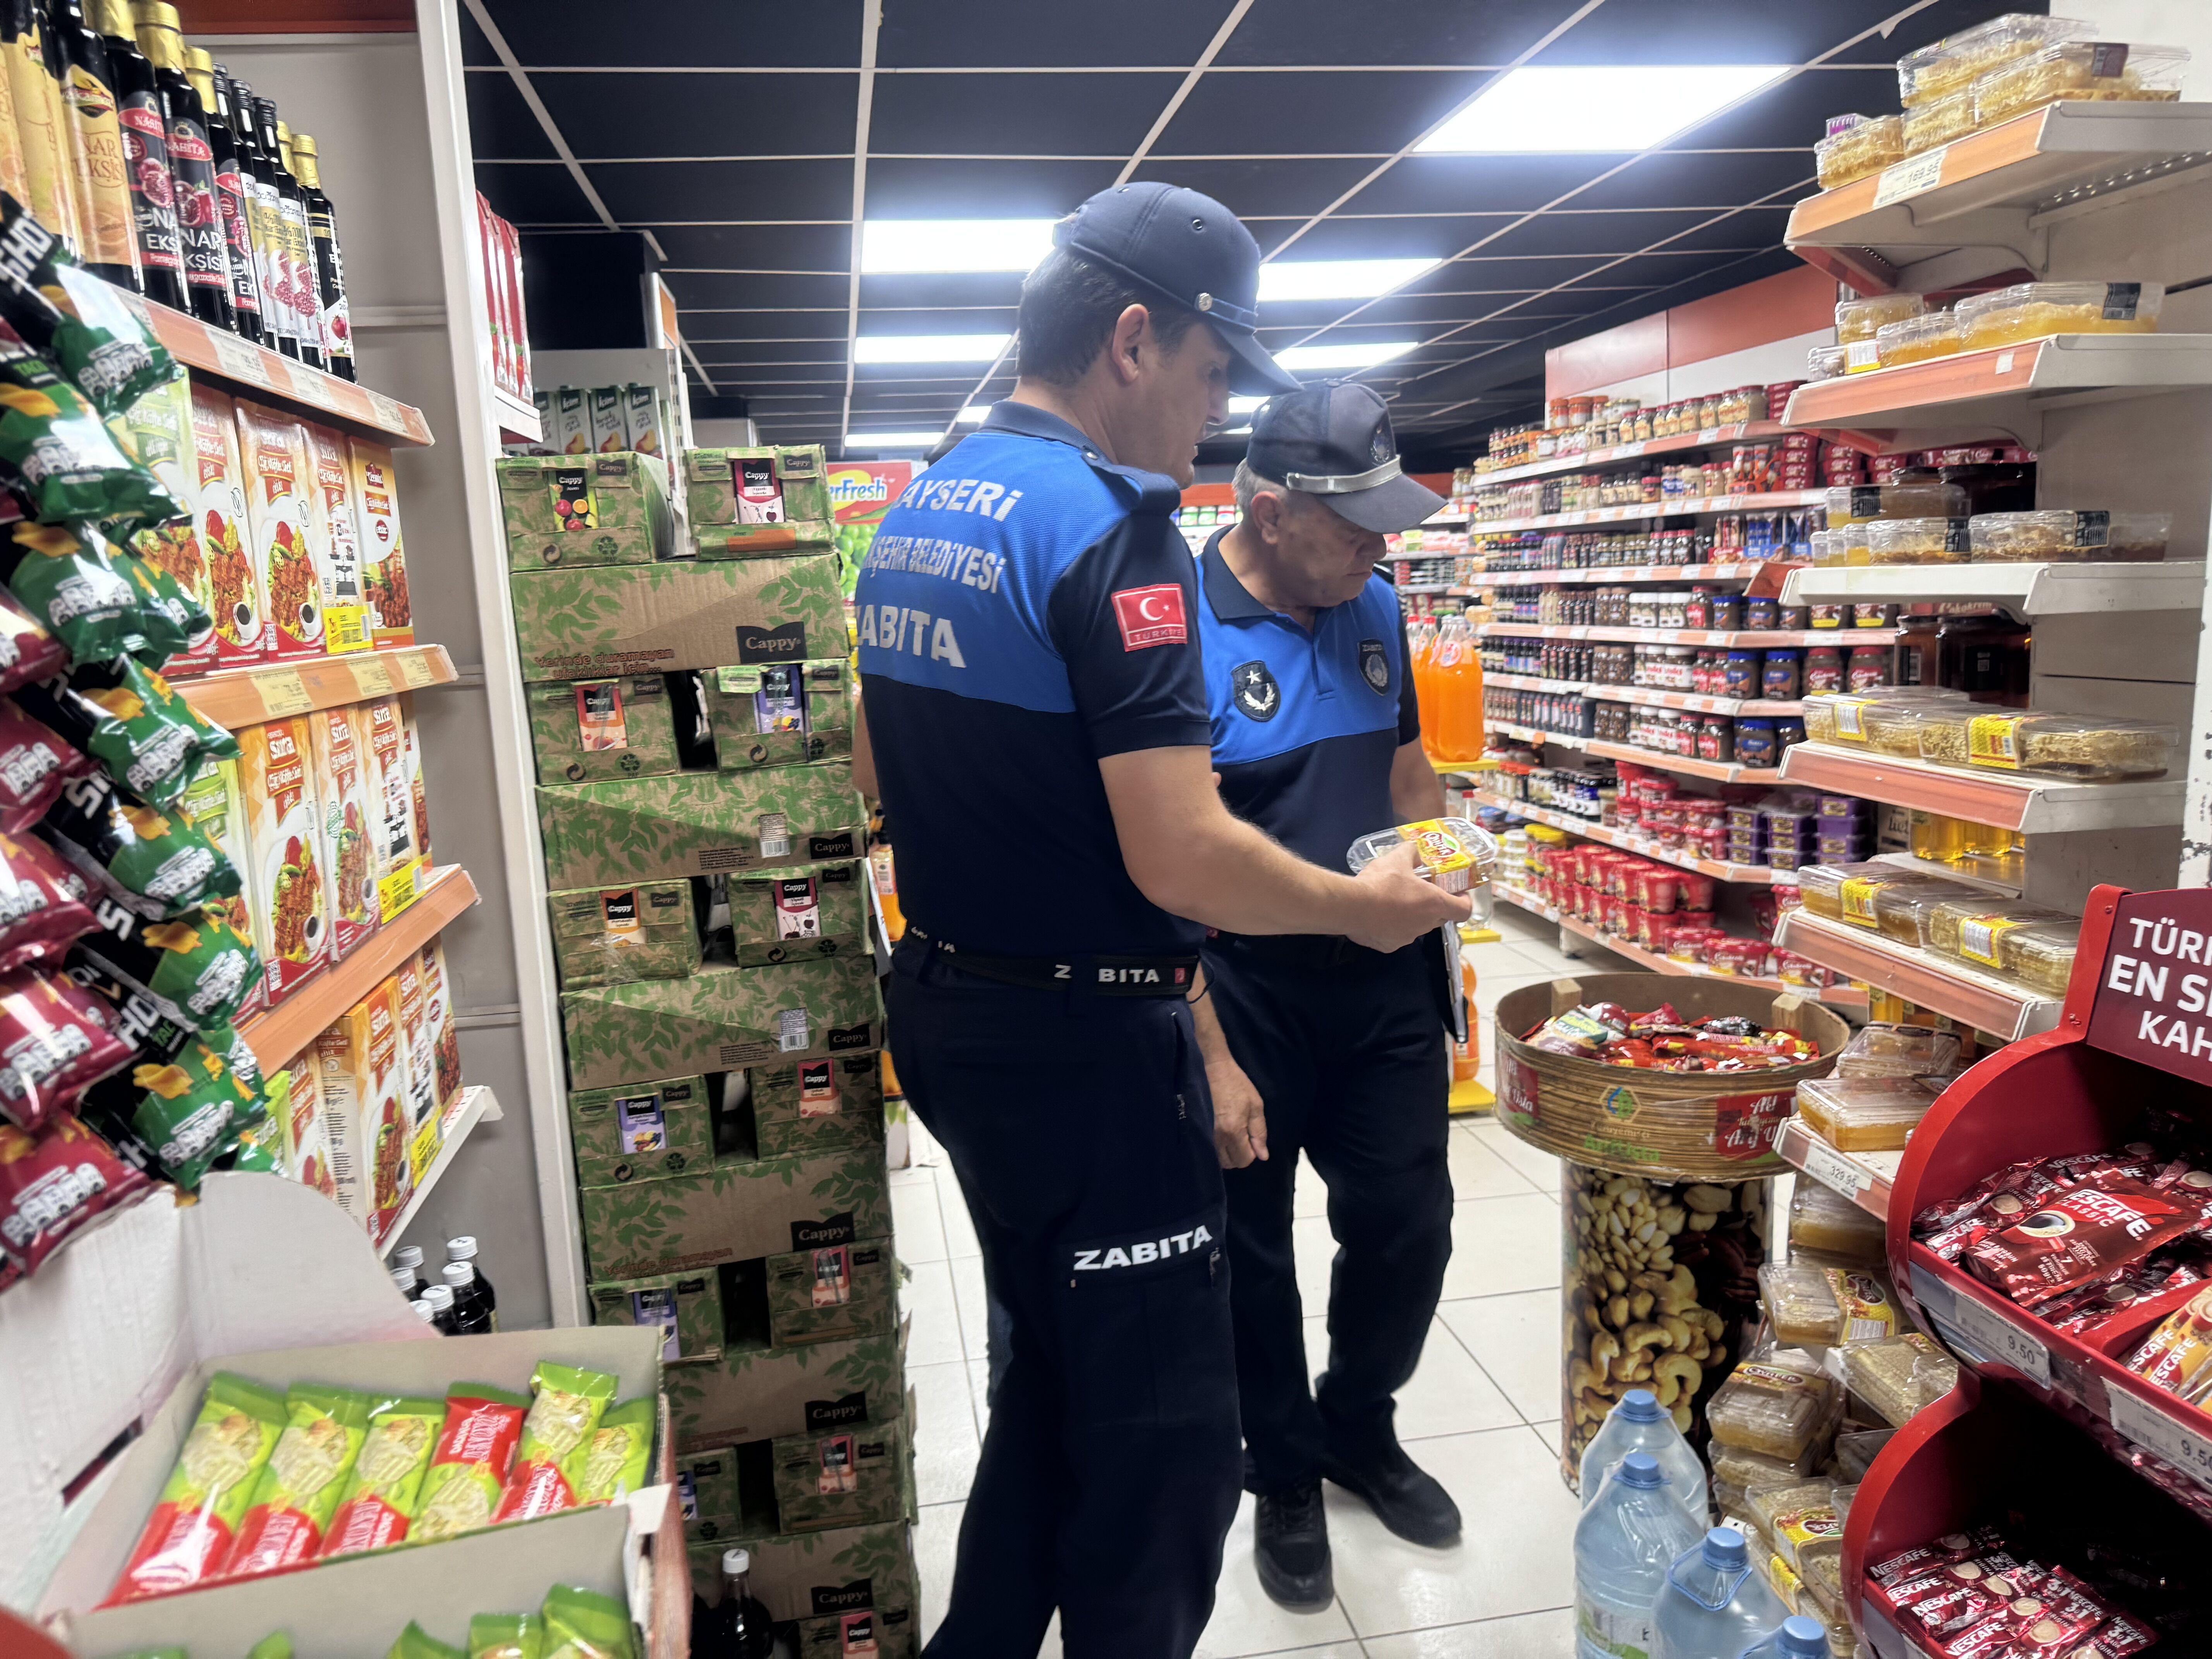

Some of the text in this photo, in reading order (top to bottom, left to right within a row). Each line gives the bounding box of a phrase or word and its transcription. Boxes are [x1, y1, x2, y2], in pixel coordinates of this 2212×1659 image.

[184, 252, 223, 272] KŞİSİ
[558, 476, 583, 485] Cappy
[893, 479, 1024, 522] AYSERİ
[908, 538, 1006, 593] BELEDİYESİ
[745, 636, 798, 653] Cappy
[595, 648, 675, 664] duramayan
[814, 843, 847, 853] Cappy
[783, 883, 807, 892] Cappy
[608, 904, 633, 913] Cappy
[1054, 964, 1160, 983] ZBITA
[2108, 954, 2212, 1018] EN S
[833, 1034, 864, 1044] Cappy
[804, 1075, 828, 1084] Cappy
[628, 1100, 653, 1109] Cappy
[1830, 1166, 1856, 1188] 329.95
[2056, 1199, 2116, 1228] CLASSIC
[2063, 1189, 2152, 1238] ESCAFE
[798, 1226, 845, 1241] Cappy
[1073, 1225, 1213, 1271] ZABITA
[2008, 1334, 2035, 1365] 9.50
[2127, 1329, 2176, 1374] ESCAFE
[2148, 1337, 2197, 1386] ESCAFE
[813, 1405, 858, 1420] Cappy
[1869, 1548, 1933, 1578] NESCAFE
[818, 1591, 863, 1604] Cappy
[1911, 1587, 1975, 1618] NESCAFE
